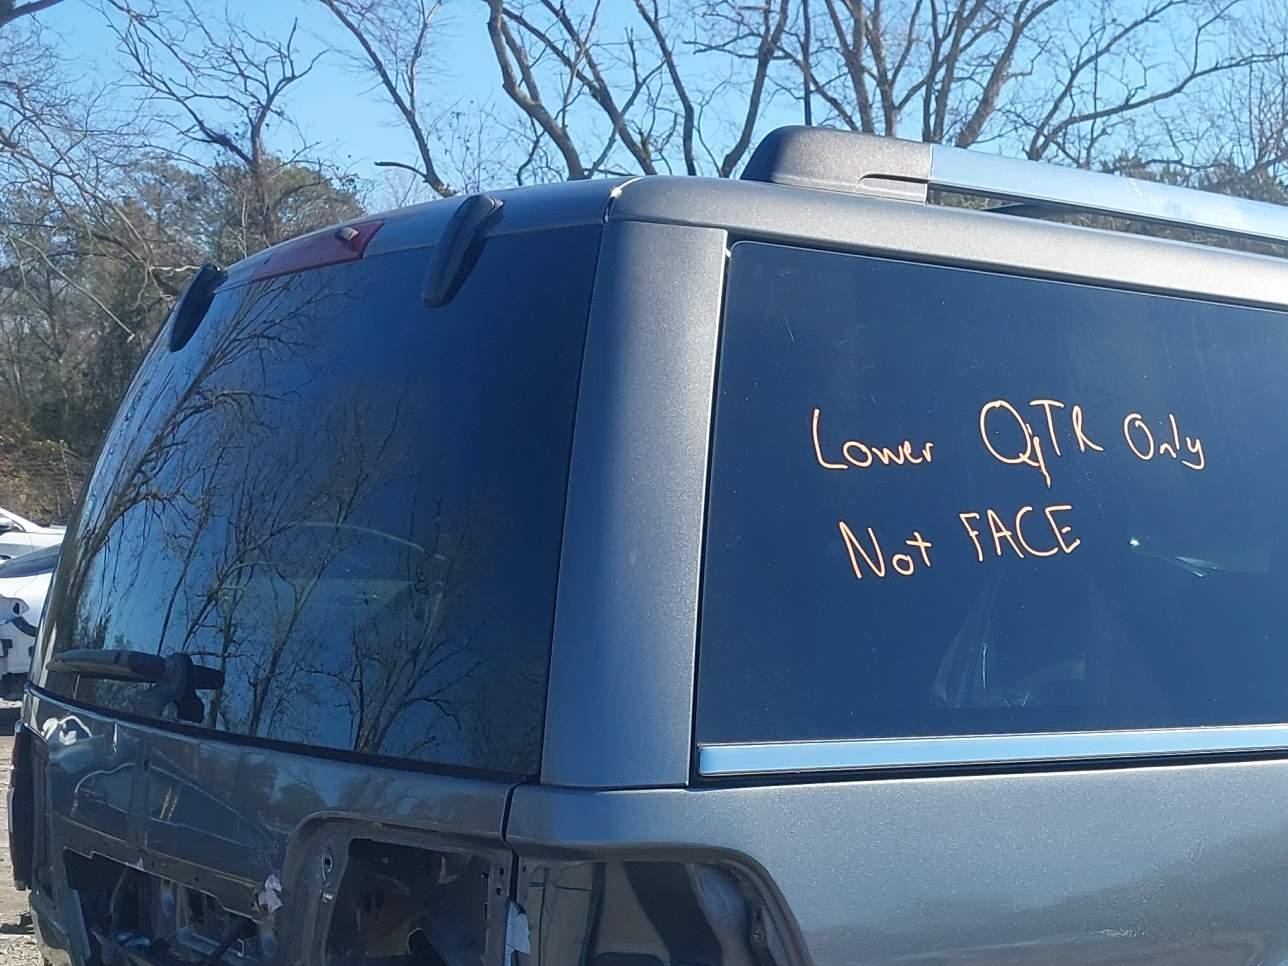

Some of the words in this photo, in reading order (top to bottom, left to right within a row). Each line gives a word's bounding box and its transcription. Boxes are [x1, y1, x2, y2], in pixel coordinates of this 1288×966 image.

[812, 408, 934, 470] Lower
[1123, 412, 1206, 470] Only
[838, 520, 932, 580] Not
[959, 504, 1081, 562] FACE
